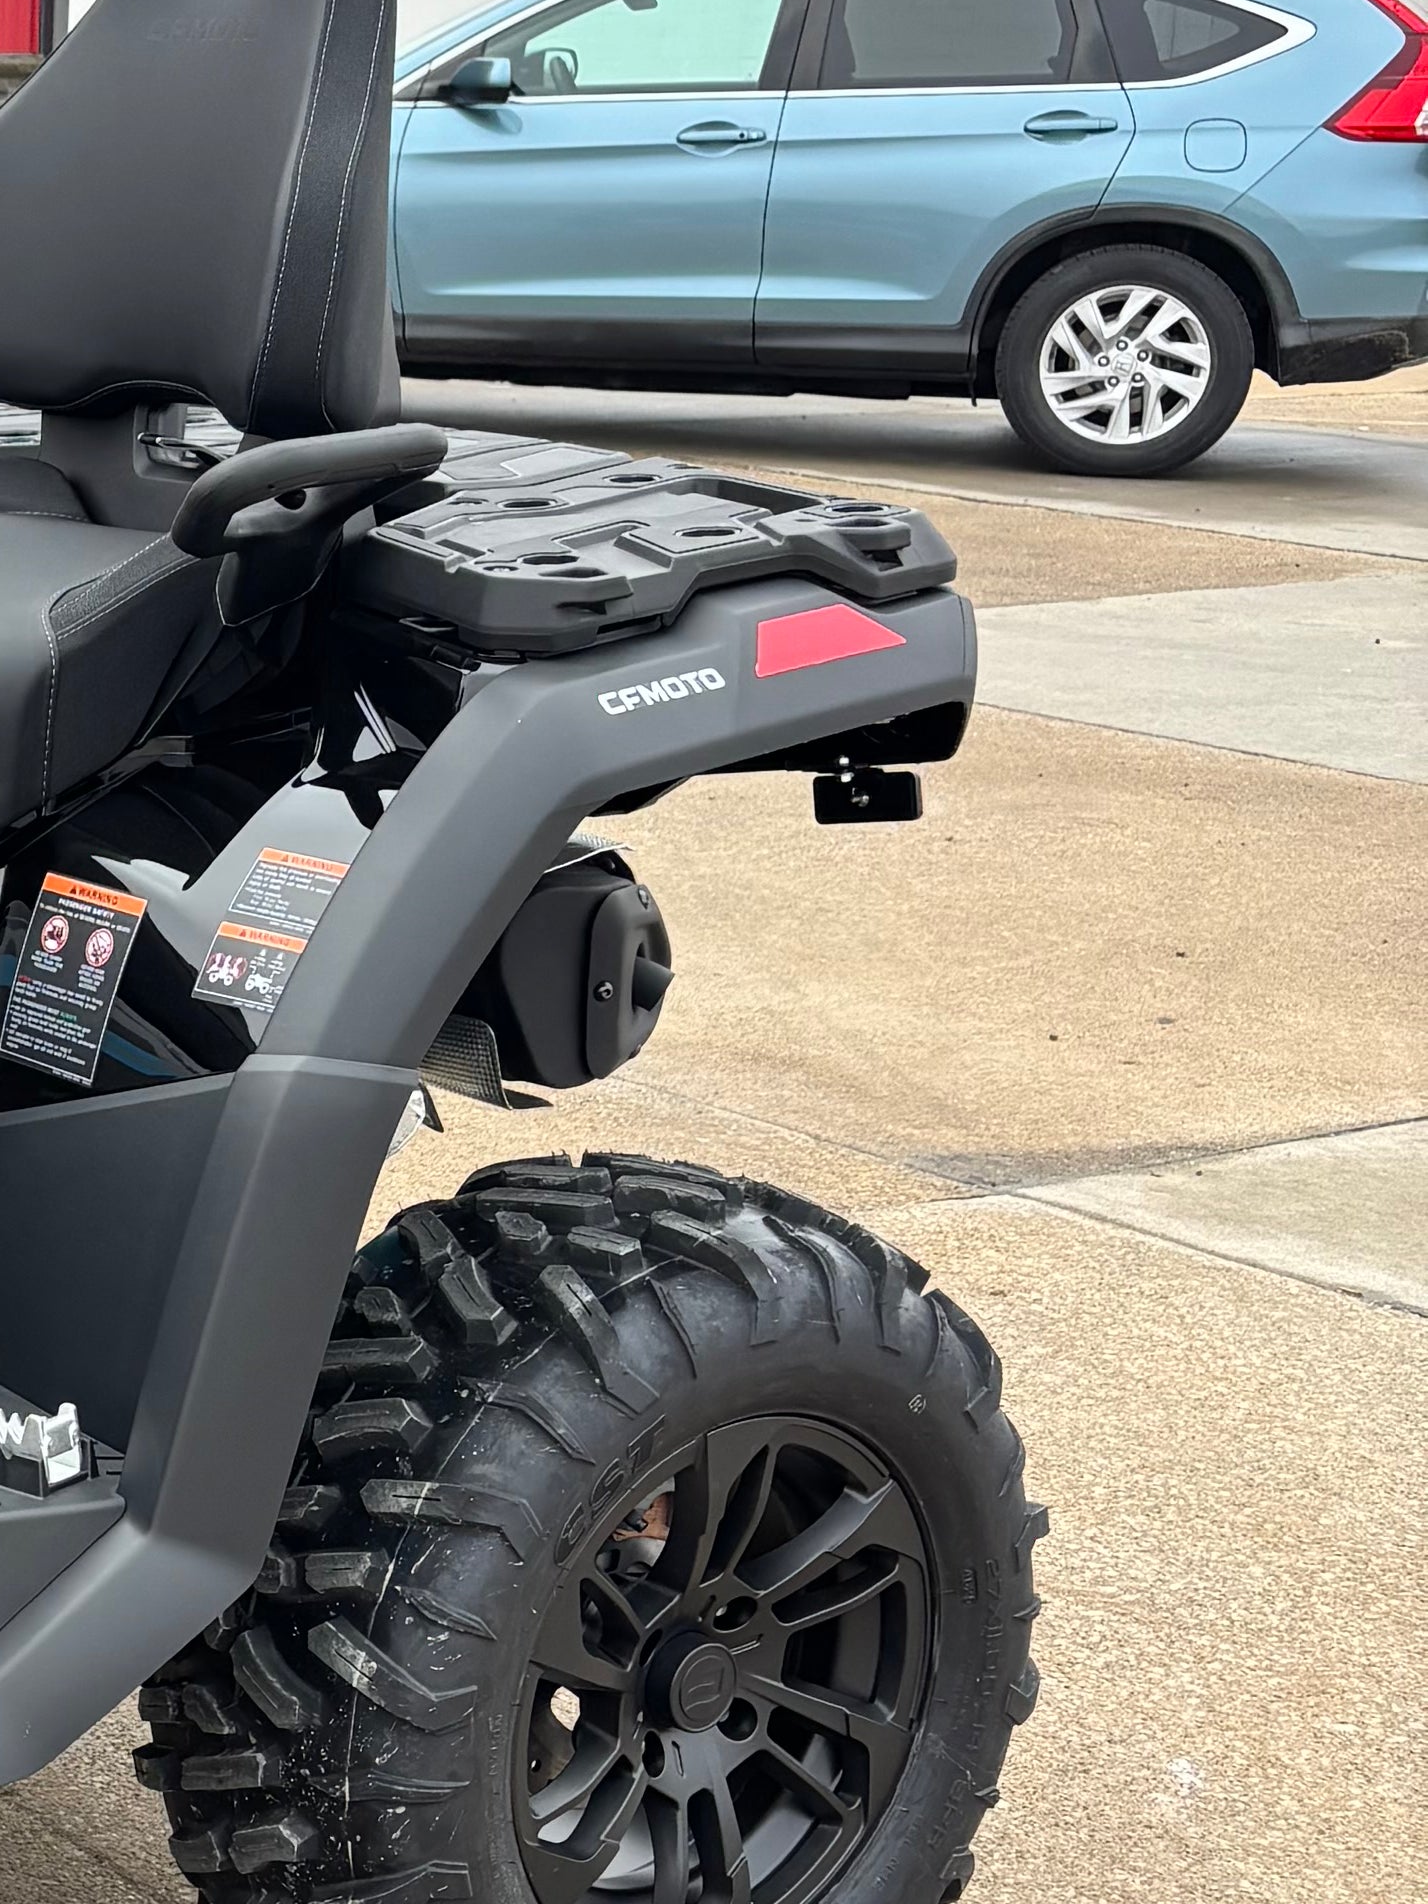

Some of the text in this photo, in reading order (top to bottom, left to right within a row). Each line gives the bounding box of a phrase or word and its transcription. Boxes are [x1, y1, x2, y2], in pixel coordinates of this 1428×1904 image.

[597, 667, 726, 715] CFMOTO
[79, 888, 118, 906] WARNING
[554, 1413, 668, 1568] CST
